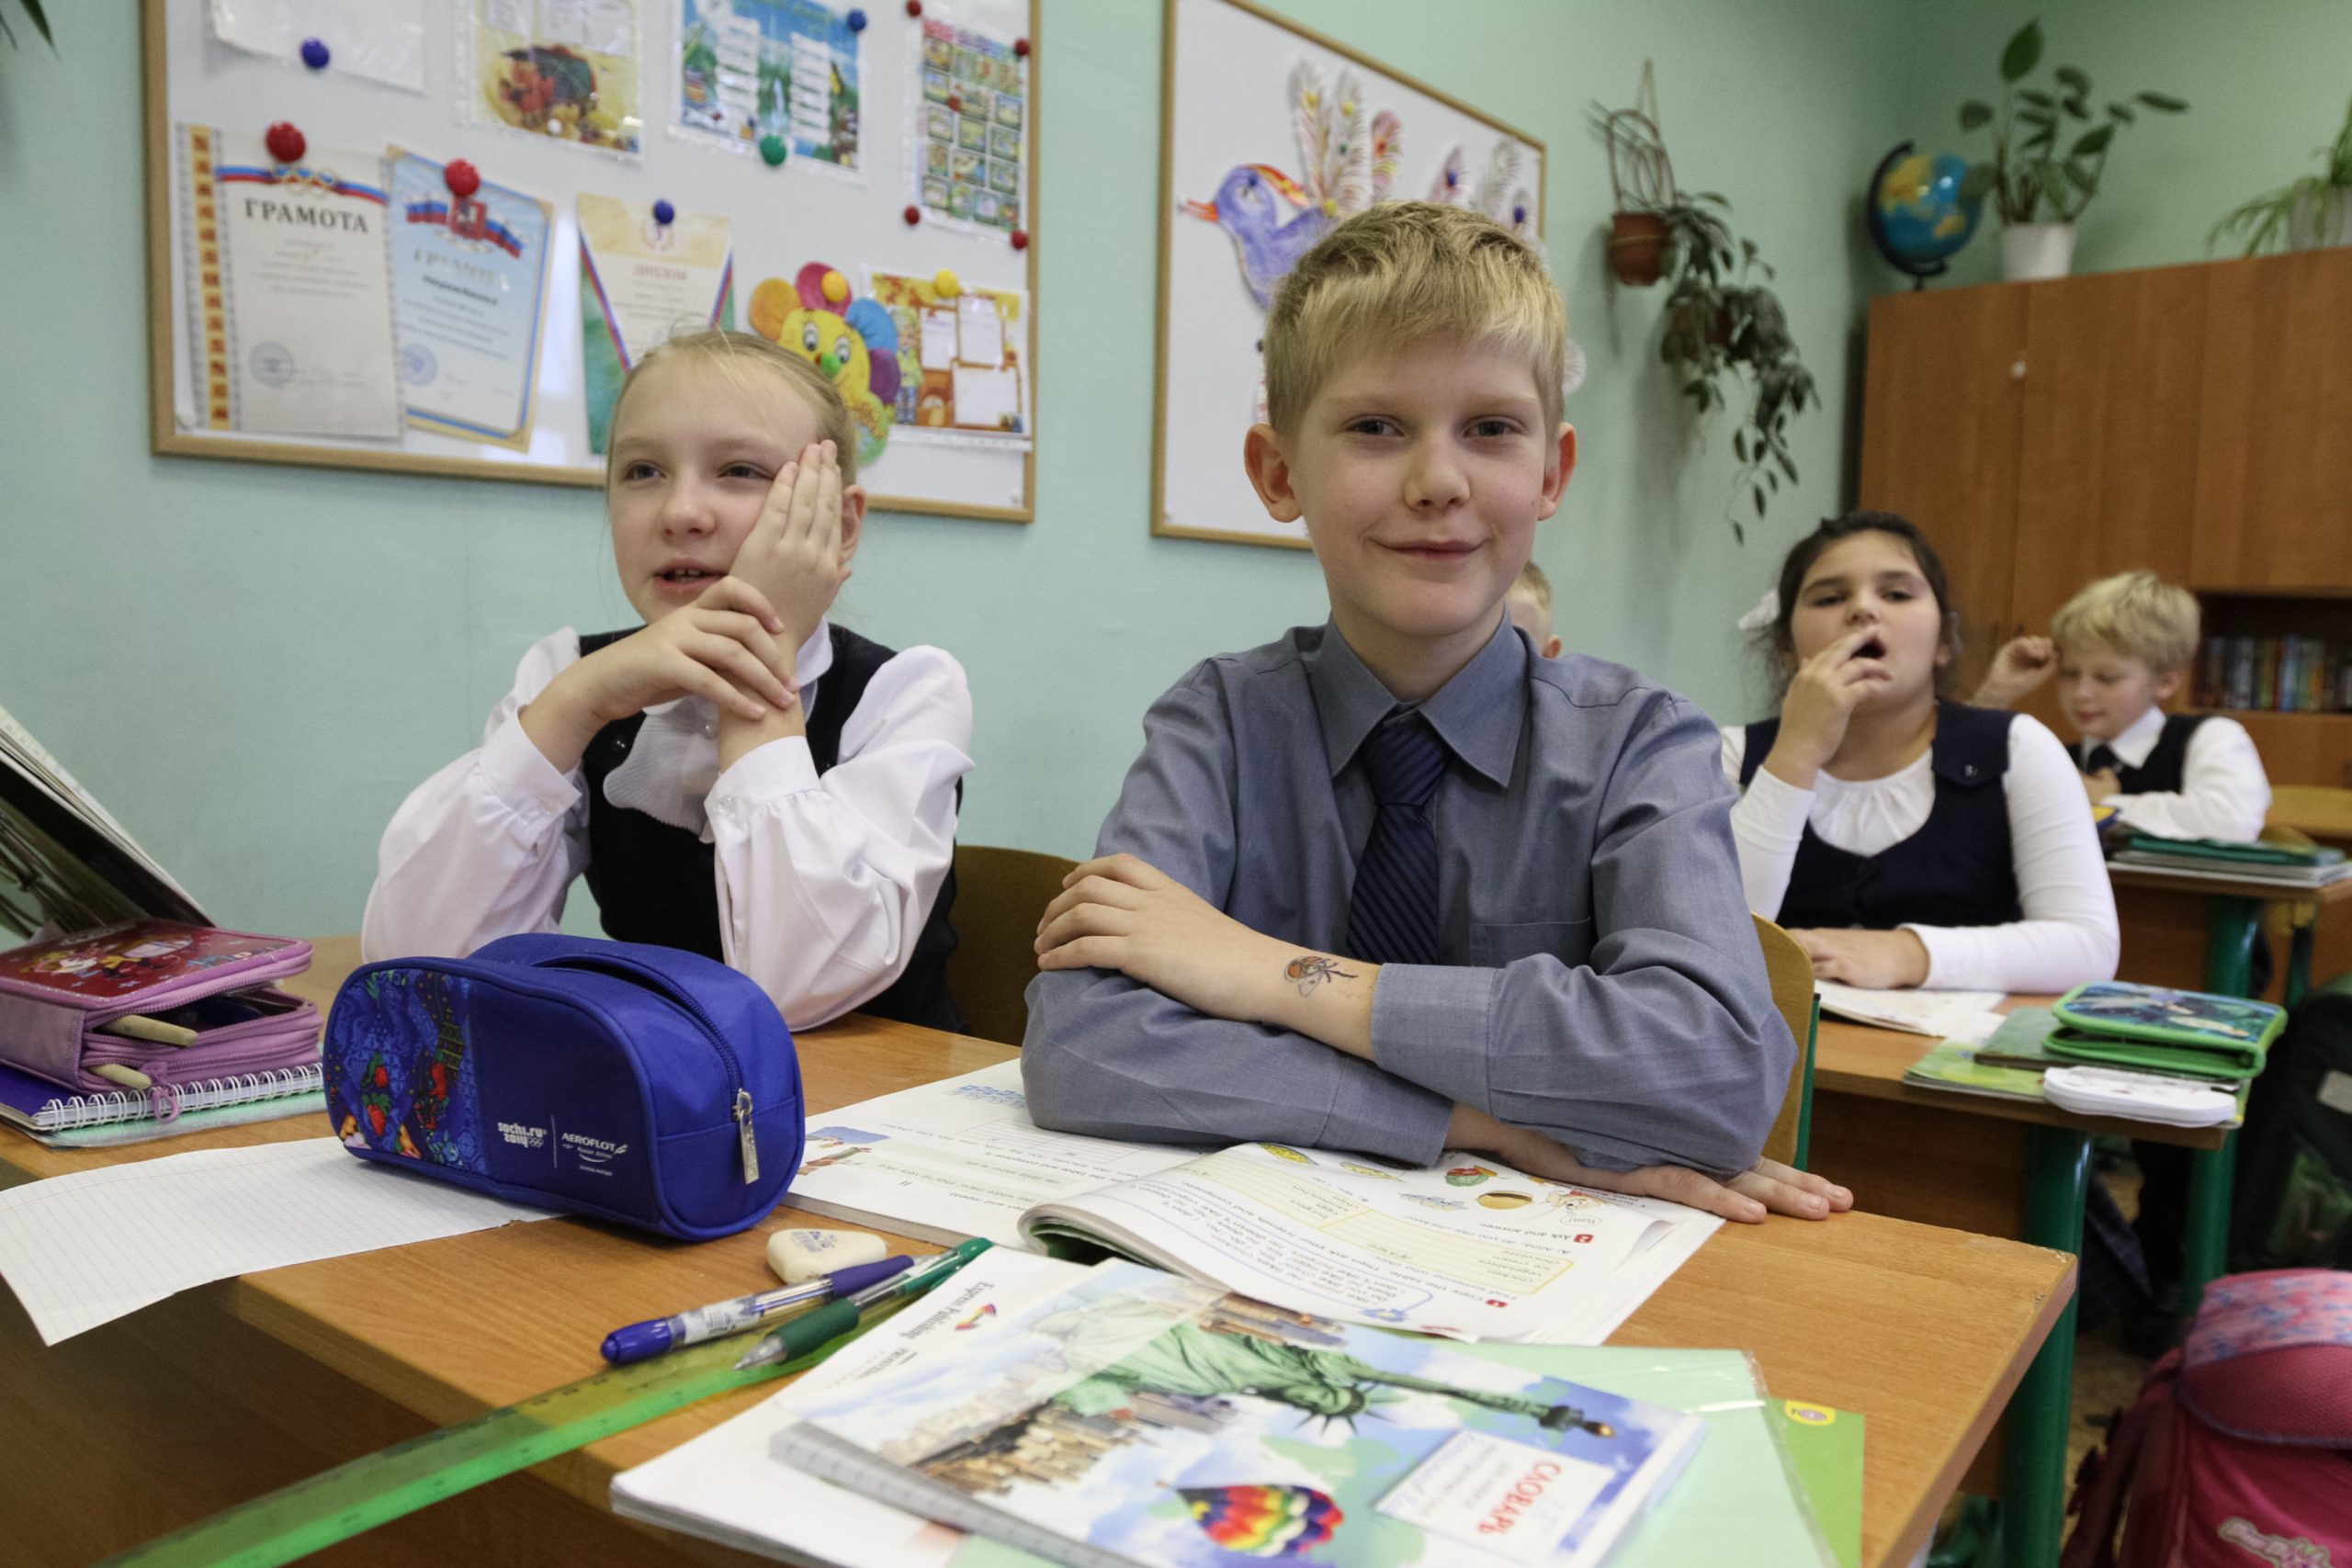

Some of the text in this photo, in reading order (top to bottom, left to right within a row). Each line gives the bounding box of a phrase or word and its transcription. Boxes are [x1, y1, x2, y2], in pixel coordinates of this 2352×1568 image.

[244, 197, 369, 234] ГРАМОТА
[498, 1122, 542, 1138] sochi.ru
[503, 1133, 529, 1148] 2014
[561, 1133, 616, 1152] AEROFLOT
[1233, 1205, 1254, 1217] and
[1258, 1217, 1295, 1238] friends
[1568, 1217, 1596, 1225] Yum!
[1299, 1238, 1327, 1250] your
[1329, 1250, 1348, 1258] ask
[1351, 1258, 1380, 1271] Then
[1426, 1282, 1447, 1292] the
[1452, 1289, 1483, 1302] Copy
[899, 1281, 995, 1340] Express Publishing
[1477, 1459, 1562, 1536] СЛОВАРЬ
